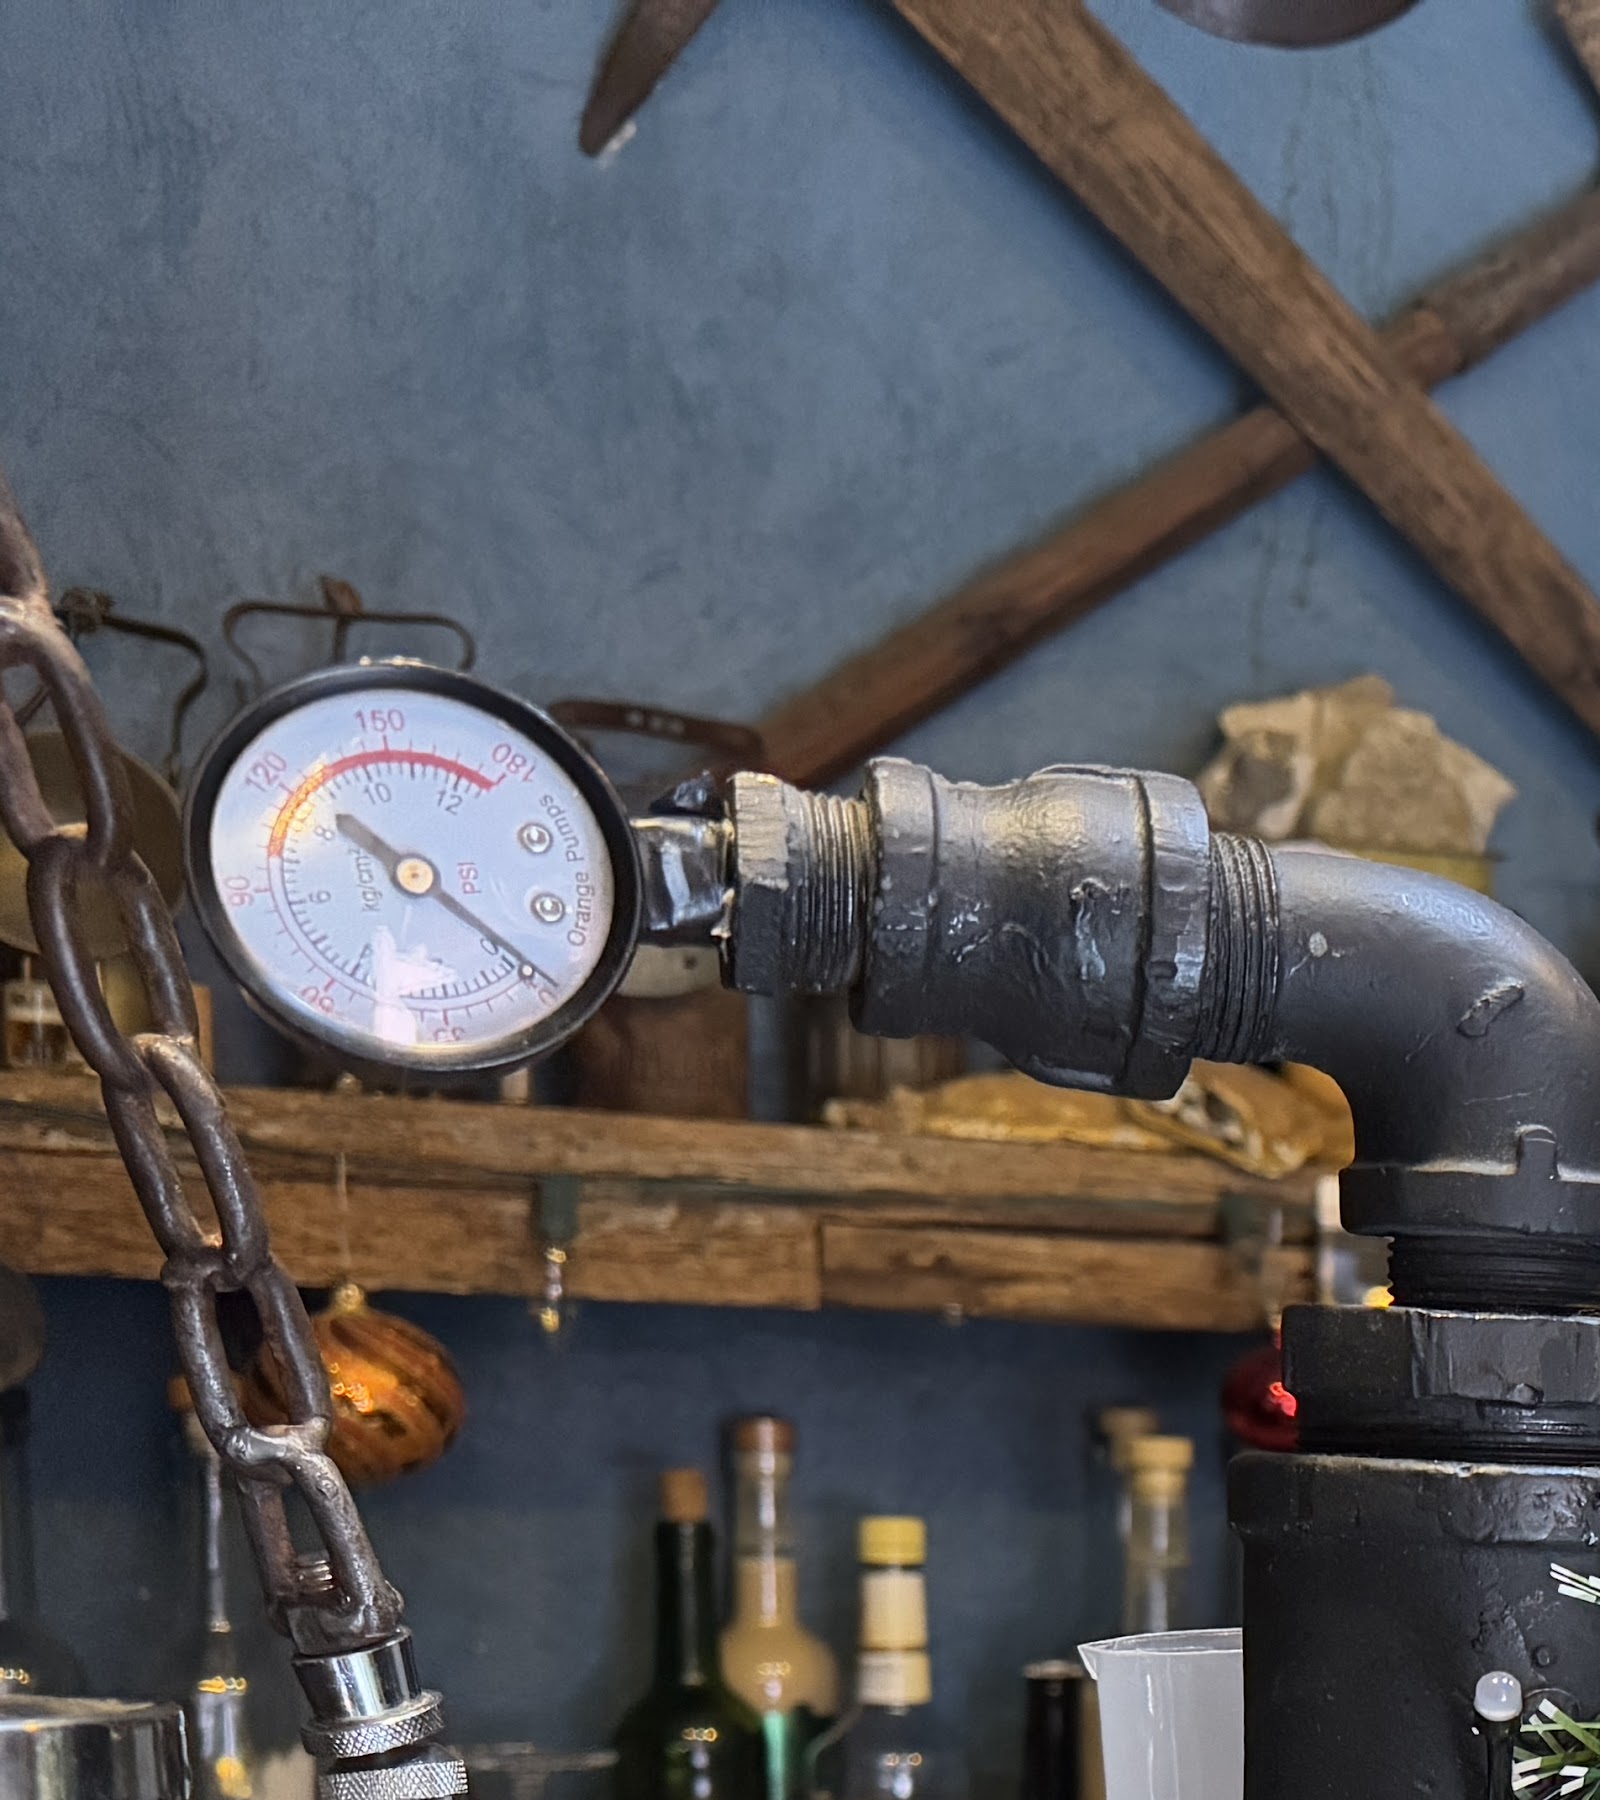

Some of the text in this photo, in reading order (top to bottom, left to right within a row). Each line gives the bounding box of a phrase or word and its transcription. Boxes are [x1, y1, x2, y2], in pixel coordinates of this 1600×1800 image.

[355, 708, 405, 732] 150
[244, 751, 288, 792] 120
[490, 742, 537, 783] 180
[363, 783, 392, 804] 10
[436, 789, 464, 815] 12
[313, 825, 335, 841] 8
[457, 862, 482, 895] PSI
[538, 794, 595, 947] Orange Pumps
[223, 875, 255, 908] 90
[308, 889, 332, 904] 6
